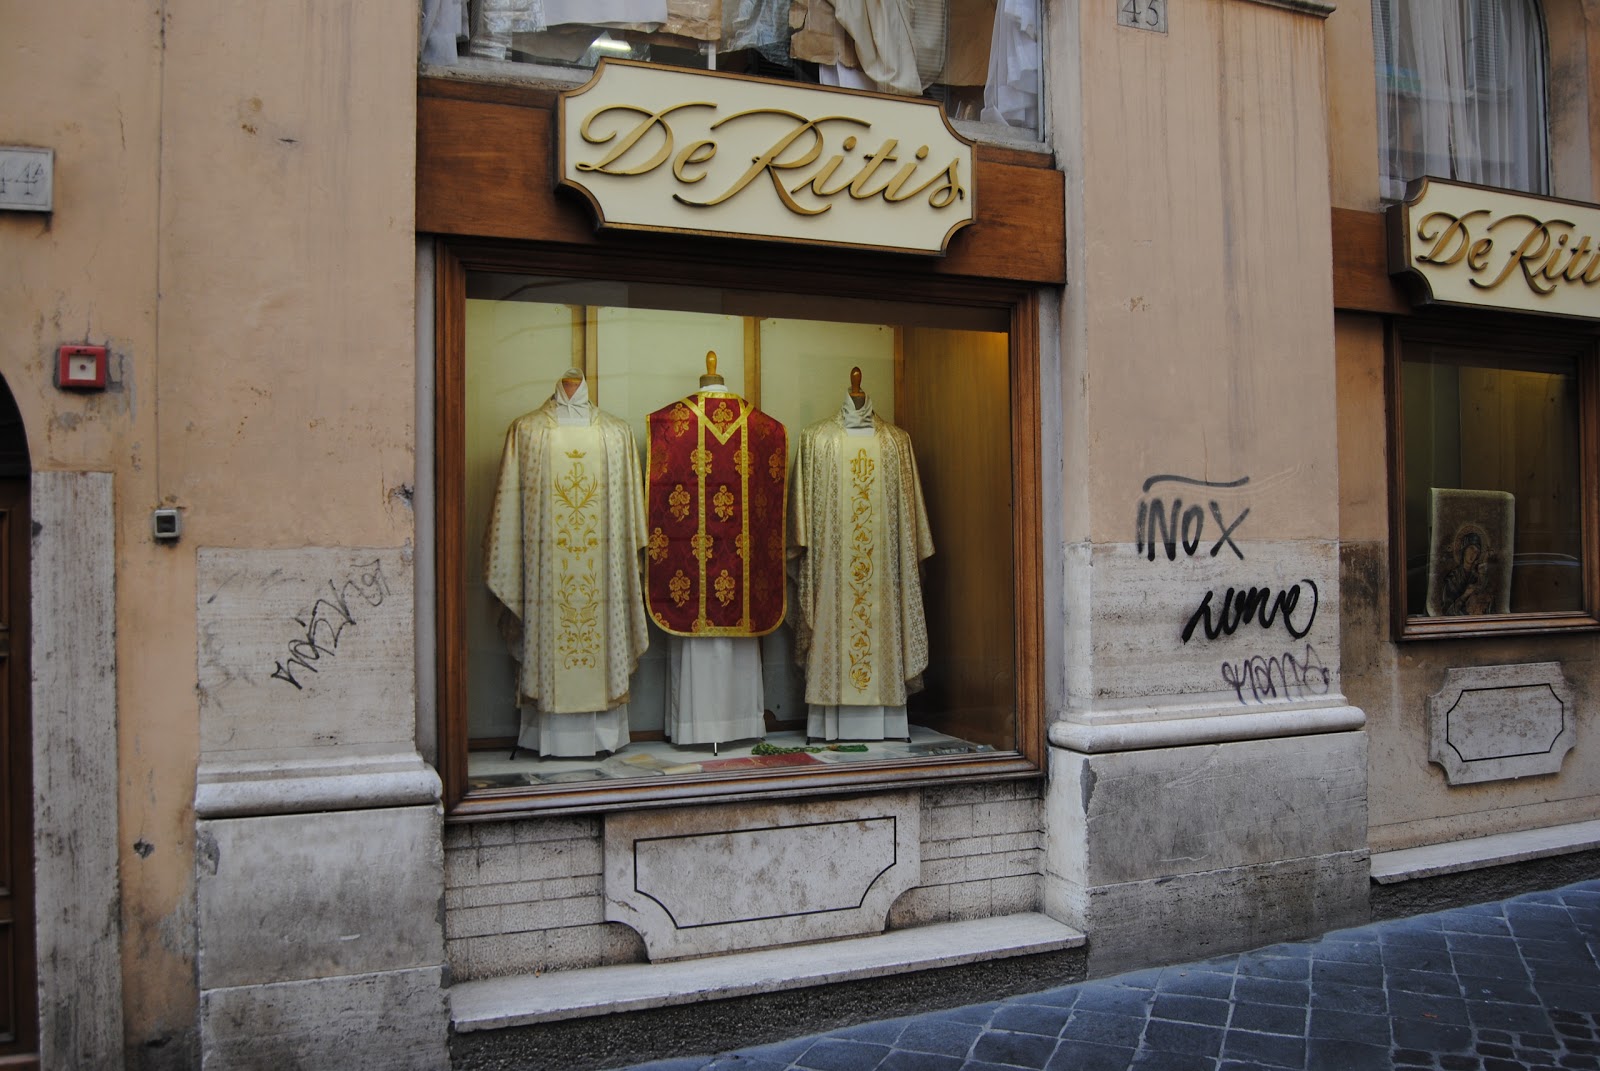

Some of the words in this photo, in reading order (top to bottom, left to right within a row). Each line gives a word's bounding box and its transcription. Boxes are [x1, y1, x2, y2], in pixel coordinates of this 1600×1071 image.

[1121, 0, 1159, 26] 45
[575, 101, 718, 184] De
[672, 107, 965, 217] Ritis
[1415, 209, 1494, 272] De
